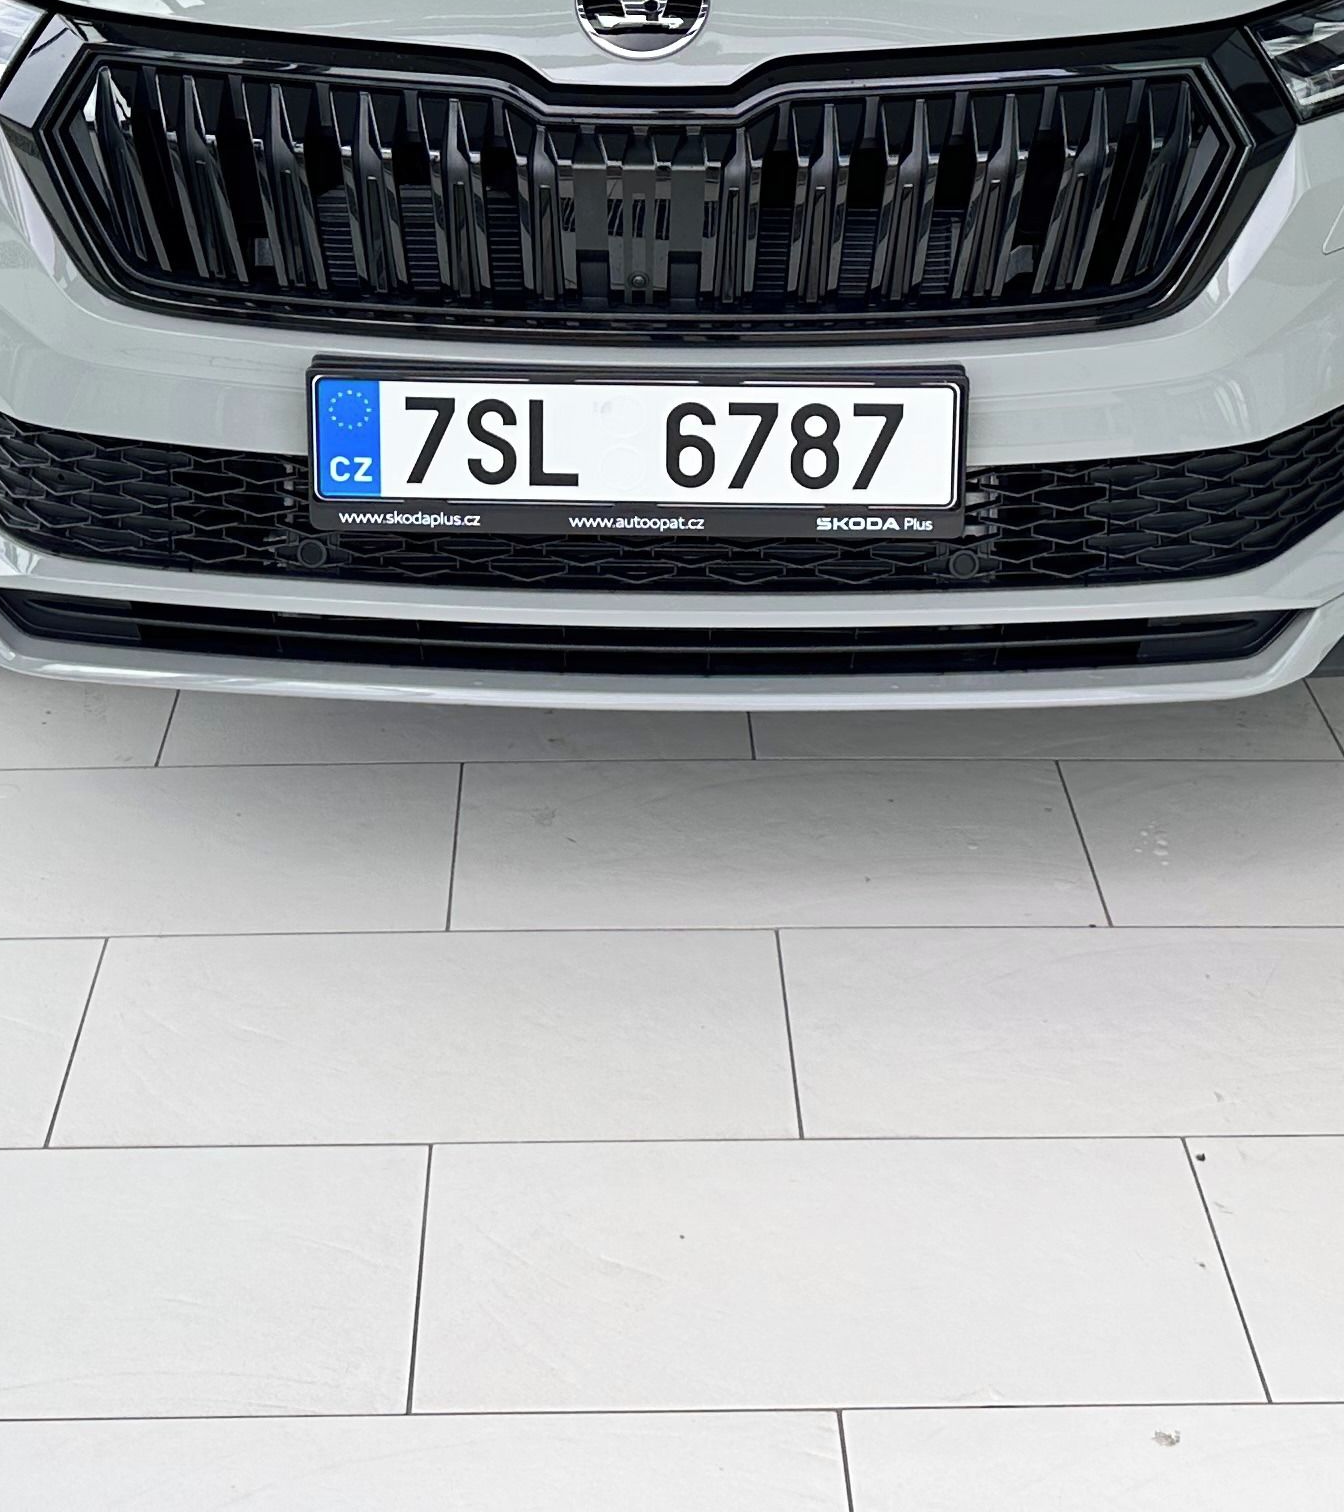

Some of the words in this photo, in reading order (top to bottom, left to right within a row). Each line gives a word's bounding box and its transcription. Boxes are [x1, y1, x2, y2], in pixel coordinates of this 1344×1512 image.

[404, 396, 579, 487] 7SL
[665, 401, 904, 490] 6787
[329, 455, 373, 483] CZ
[338, 510, 481, 528] www.skodaplus.cz
[568, 516, 705, 532] www.autoopat.cz
[903, 517, 934, 531] Plus
